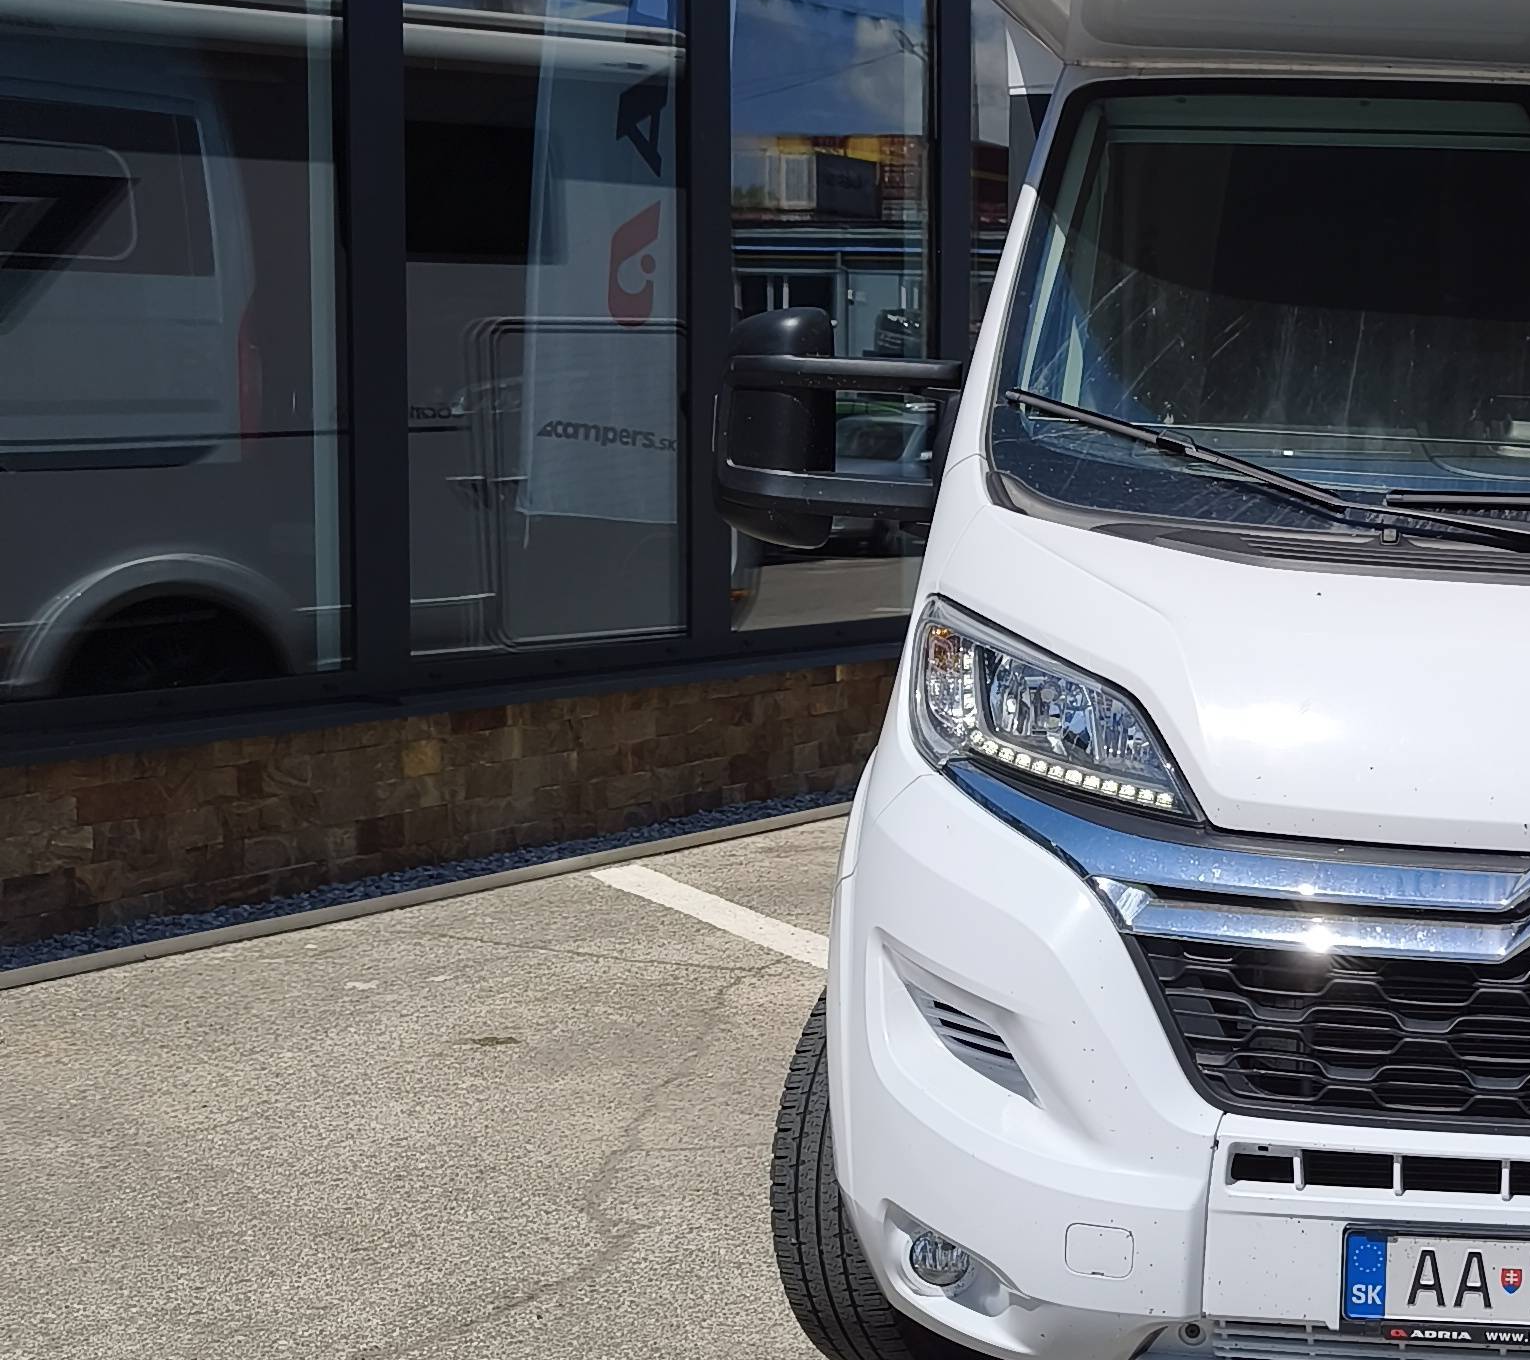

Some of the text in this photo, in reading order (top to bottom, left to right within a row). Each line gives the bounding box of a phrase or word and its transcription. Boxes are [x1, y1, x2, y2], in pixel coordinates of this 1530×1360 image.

[1351, 1283, 1383, 1306] SK
[1407, 1249, 1493, 1309] AA
[1410, 1329, 1472, 1341] ADRIA
